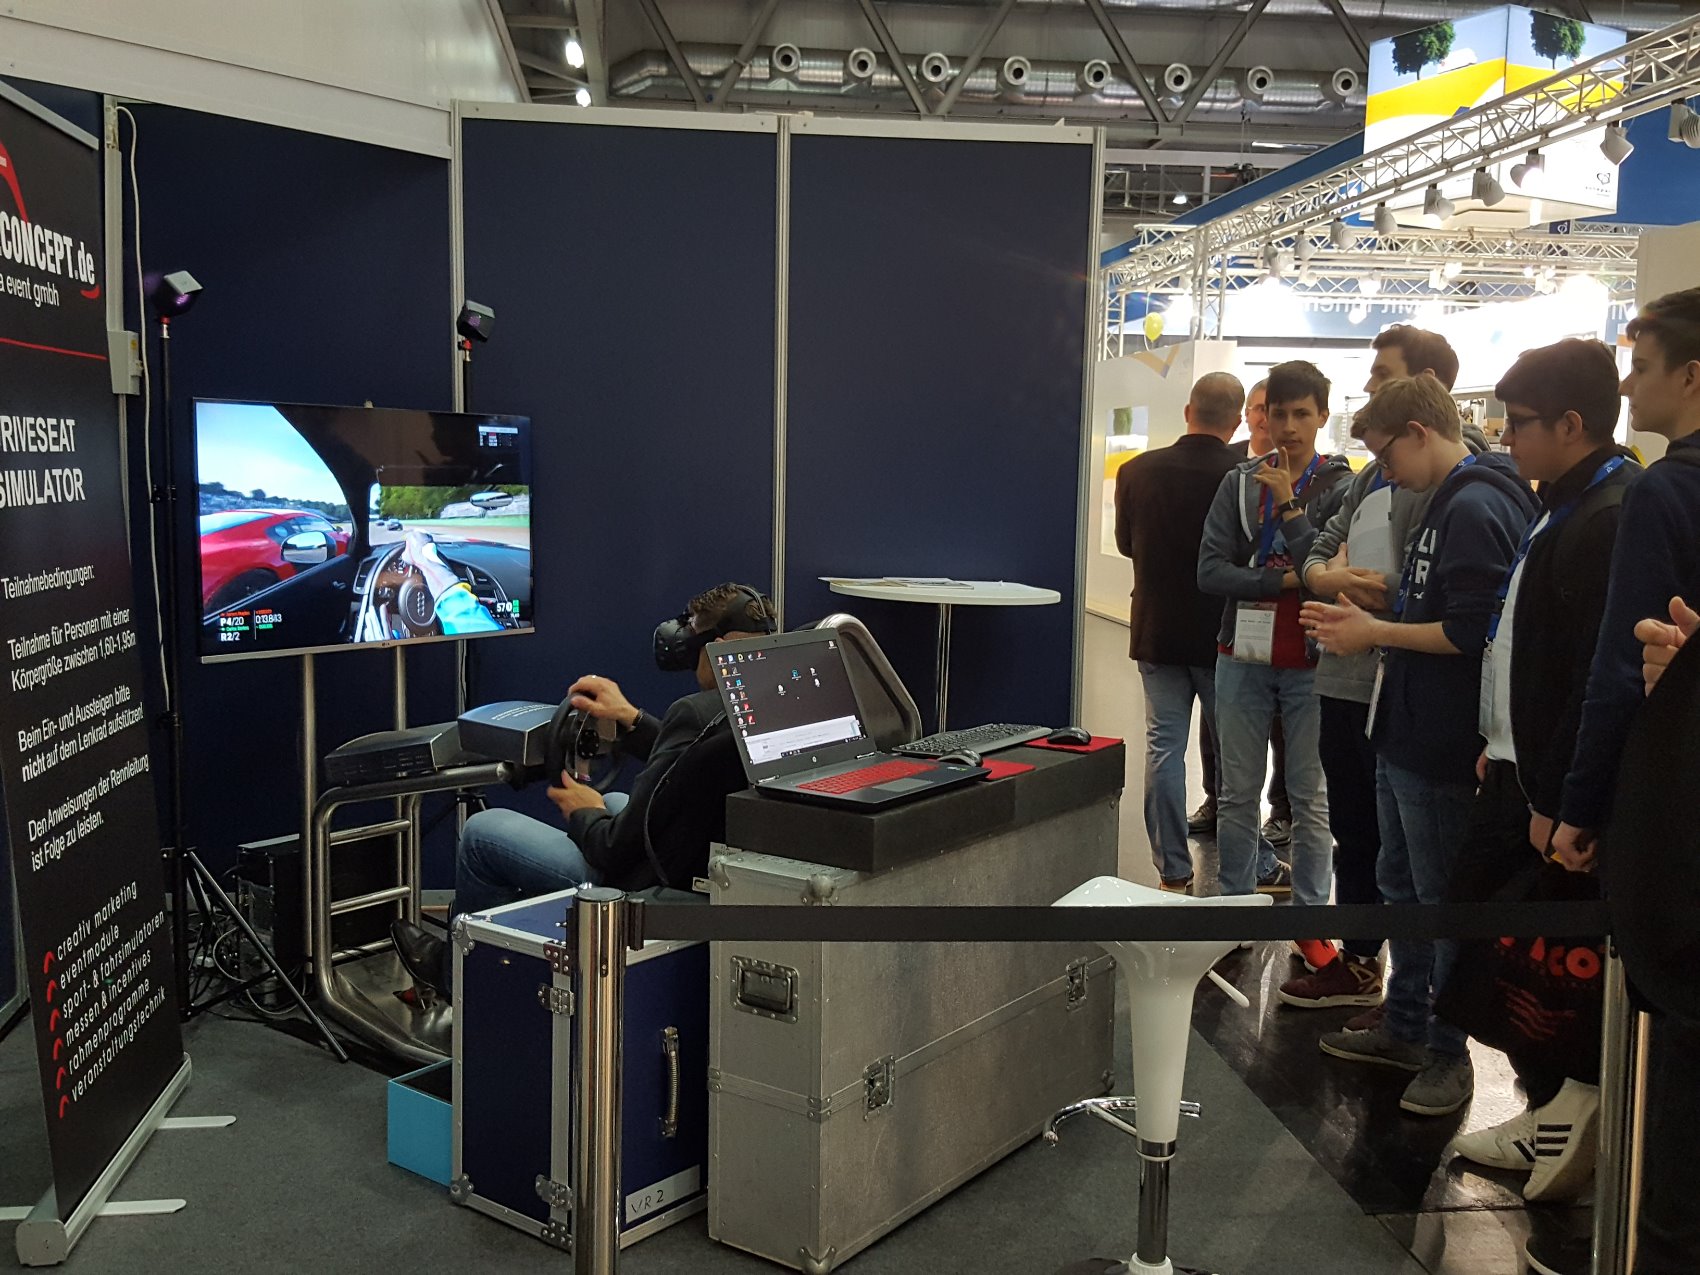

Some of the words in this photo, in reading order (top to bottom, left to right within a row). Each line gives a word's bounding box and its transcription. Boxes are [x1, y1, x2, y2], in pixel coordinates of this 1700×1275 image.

[0, 210, 95, 285] CONCEPT.de
[7, 275, 32, 300] event
[33, 281, 60, 308] gmbh
[1, 565, 95, 600] Teilnahmebedingungen:
[7, 633, 51, 660] Teilnahme
[51, 624, 63, 647] für
[64, 617, 100, 642] Personen
[100, 610, 113, 629] mit
[113, 608, 130, 626] einer
[220, 617, 244, 626] P4/20
[220, 632, 240, 641] R2/2
[11, 655, 63, 692] Körpergröße
[64, 645, 98, 672] zwischen
[99, 629, 136, 660] 1,60-1,95m
[18, 726, 43, 752] Beim
[42, 718, 58, 741] Ein-
[58, 706, 75, 732] und
[75, 695, 115, 724] Aussteigen
[114, 685, 131, 708] bitte
[22, 754, 47, 783] nicht
[46, 744, 60, 769] auf
[59, 736, 78, 761] dem
[78, 723, 109, 752] Lenkrad
[108, 702, 144, 734] aufstützen!
[28, 818, 50, 843] Den
[48, 786, 98, 827] Anweisungen
[98, 776, 110, 800] der
[110, 755, 149, 788] Rennleitung
[31, 848, 45, 872] ist
[44, 832, 66, 864] Folge
[65, 827, 78, 848] zu
[76, 811, 105, 840] leisten.
[57, 919, 91, 962] creativ
[94, 880, 138, 928] marketing
[60, 922, 120, 990] eventmodule
[62, 982, 92, 1019] sport-
[92, 970, 100, 989] &
[100, 910, 165, 981] fahrsimulatoren
[65, 1005, 101, 1047] messen
[101, 991, 108, 1010] &
[107, 949, 152, 999] incentives
[68, 976, 150, 1076] rahmenprogramme
[71, 984, 166, 1103] veranstaltungstechnik
[631, 1195, 651, 1213] VR
[656, 1189, 664, 1204] 2
